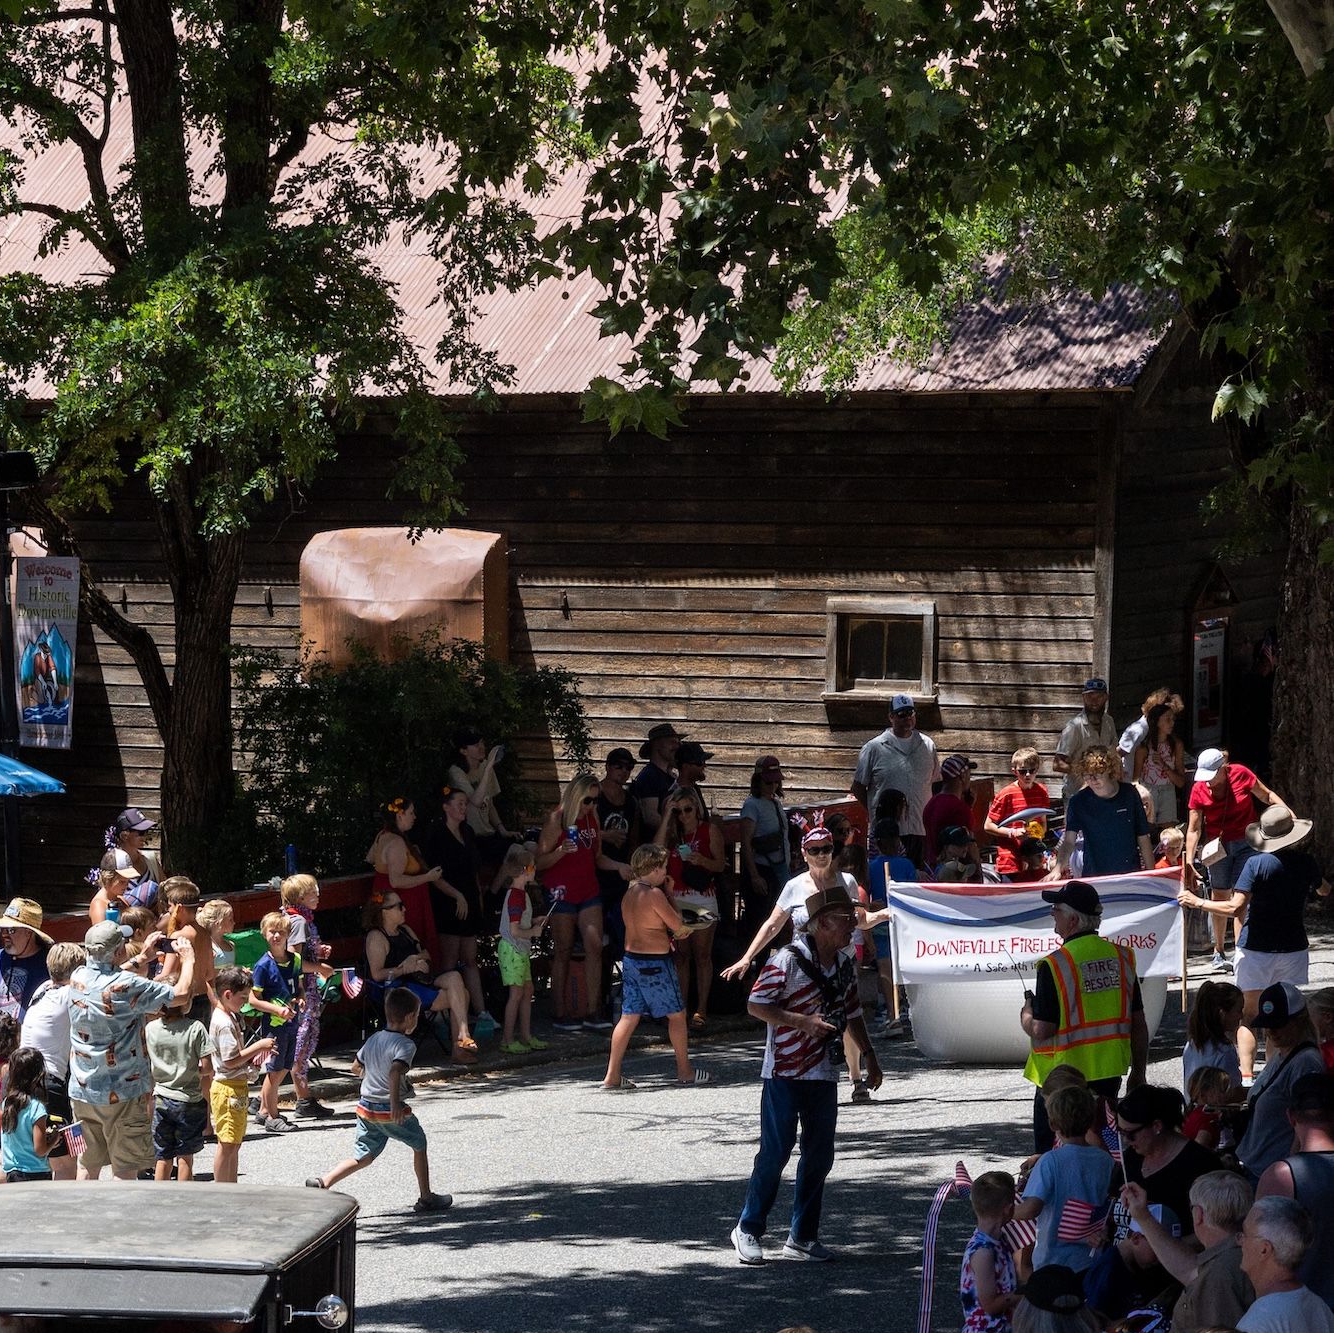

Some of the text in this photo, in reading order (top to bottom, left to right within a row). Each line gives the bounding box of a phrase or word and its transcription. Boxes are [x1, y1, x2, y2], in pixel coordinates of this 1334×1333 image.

[25, 564, 73, 580] Welcome
[44, 576, 54, 586] to
[28, 586, 71, 602] Historic
[18, 602, 77, 619] Downieville
[973, 963, 982, 973] A
[985, 962, 1008, 973] Safe
[1087, 959, 1114, 973] FIRE
[1084, 975, 1120, 991] RESCUE
